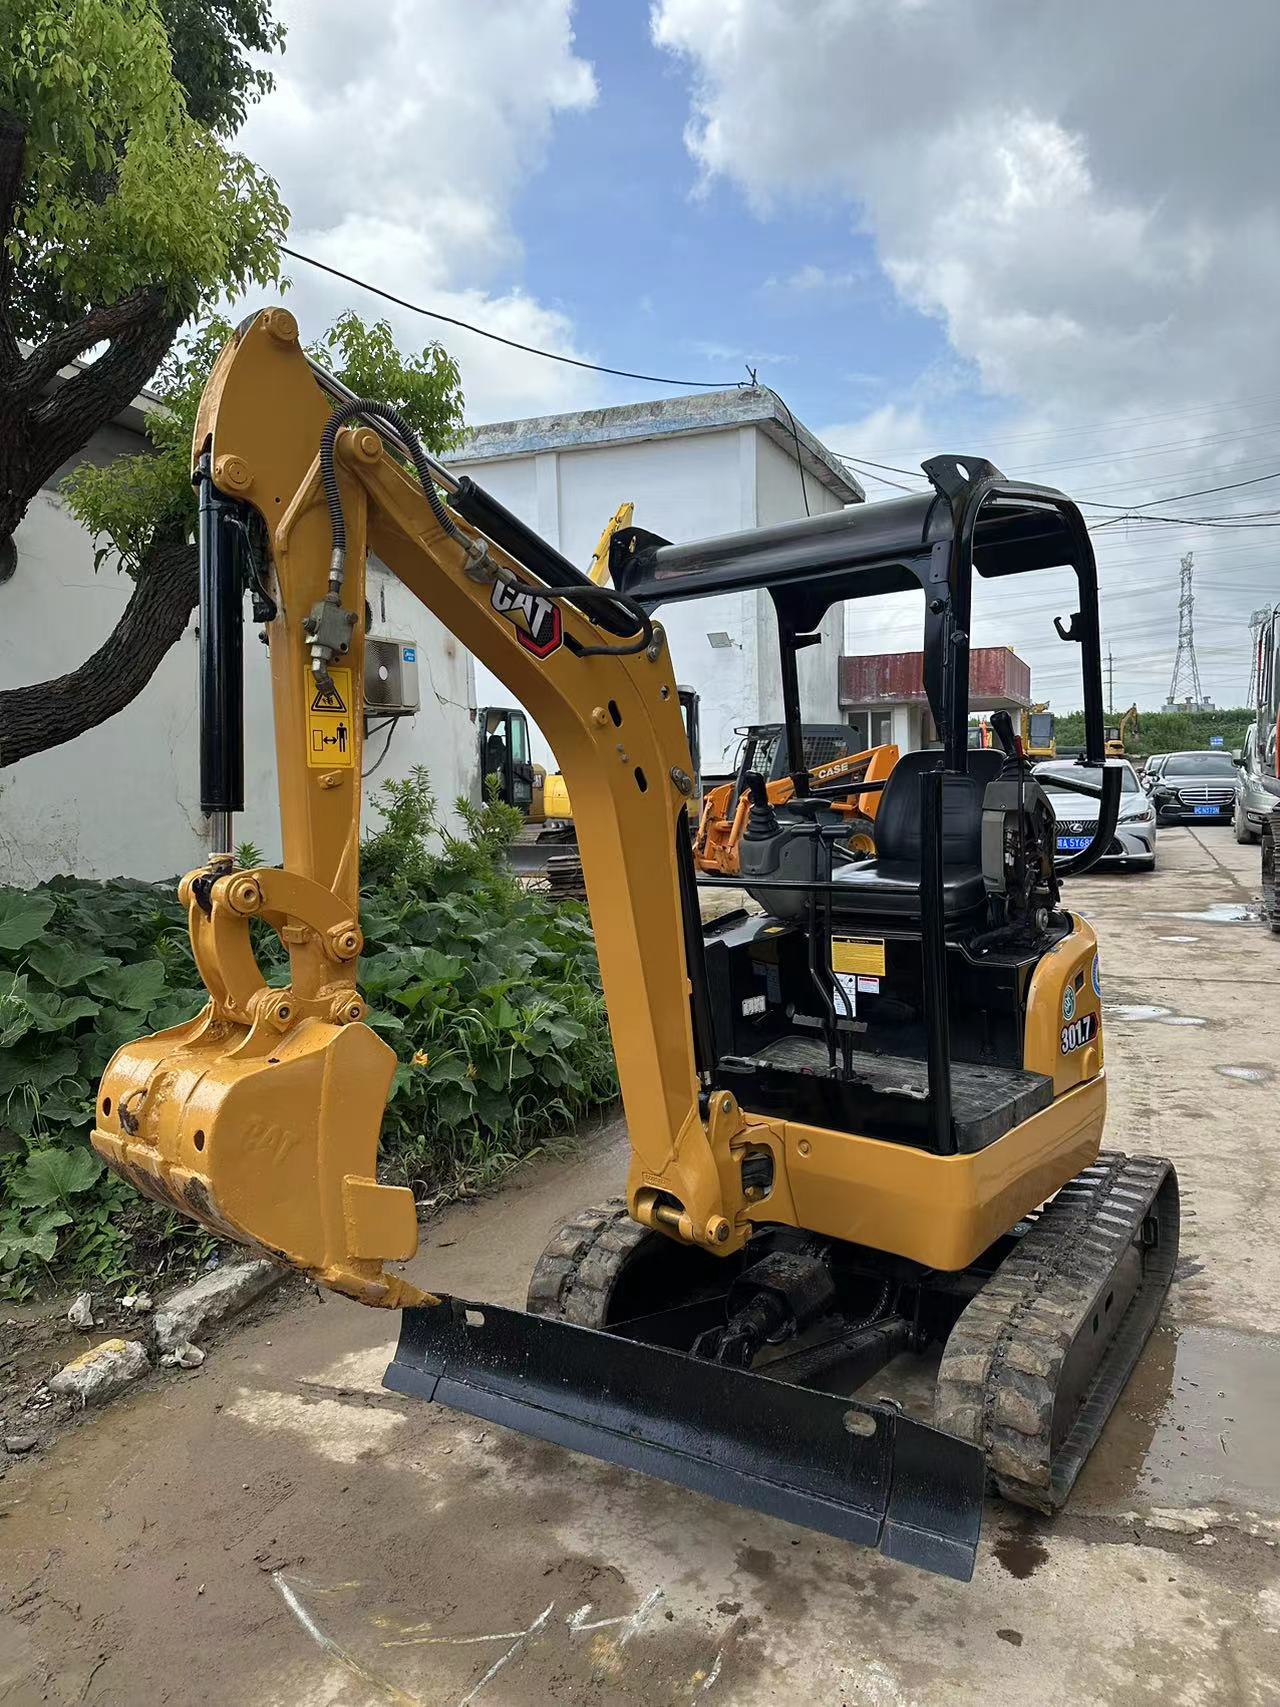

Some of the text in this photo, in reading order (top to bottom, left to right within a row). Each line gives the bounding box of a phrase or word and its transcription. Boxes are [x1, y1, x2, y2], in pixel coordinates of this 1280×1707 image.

[491, 568, 554, 639] CAT
[818, 762, 849, 779] CASE
[1061, 1015, 1091, 1053] 301.7
